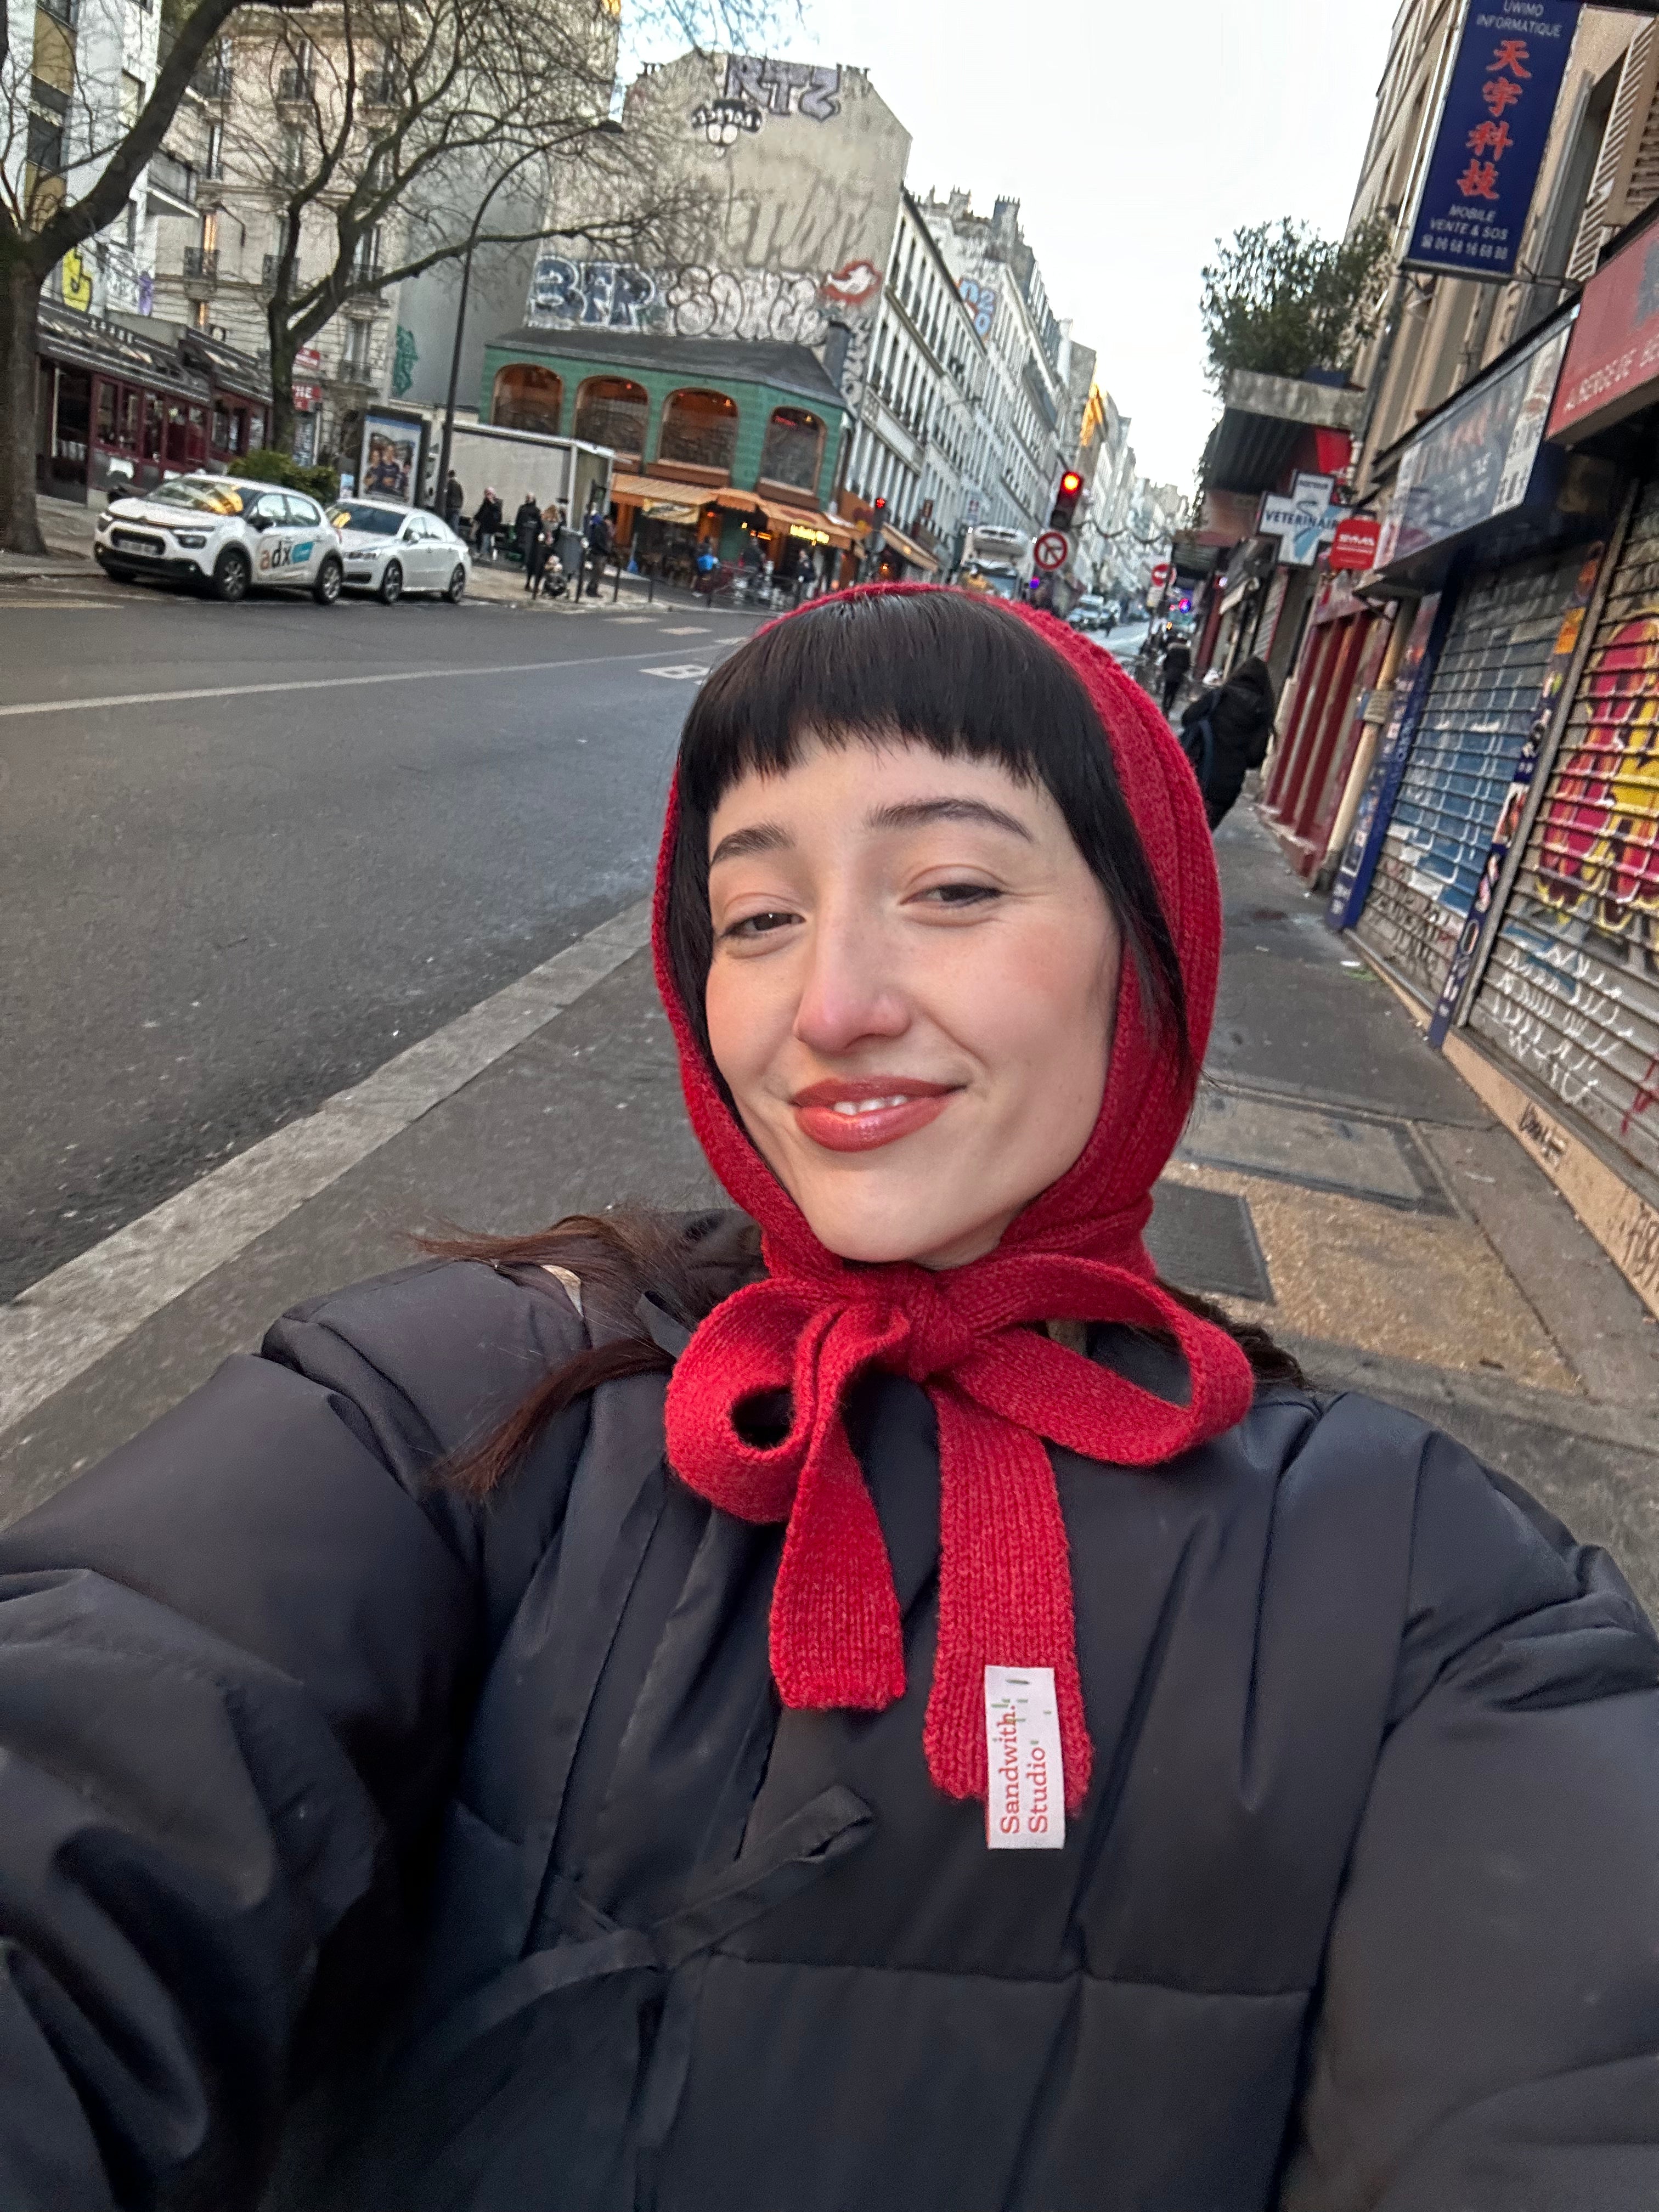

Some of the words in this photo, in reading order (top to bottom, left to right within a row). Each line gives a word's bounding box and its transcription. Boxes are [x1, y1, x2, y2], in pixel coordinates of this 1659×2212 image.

[1476, 14, 1562, 37] INFORMATIQUE
[1457, 40, 1532, 199] 天宇科技
[1449, 205, 1496, 223] MOBILE
[260, 540, 291, 570] adx
[1025, 1747, 1048, 1833] Studio
